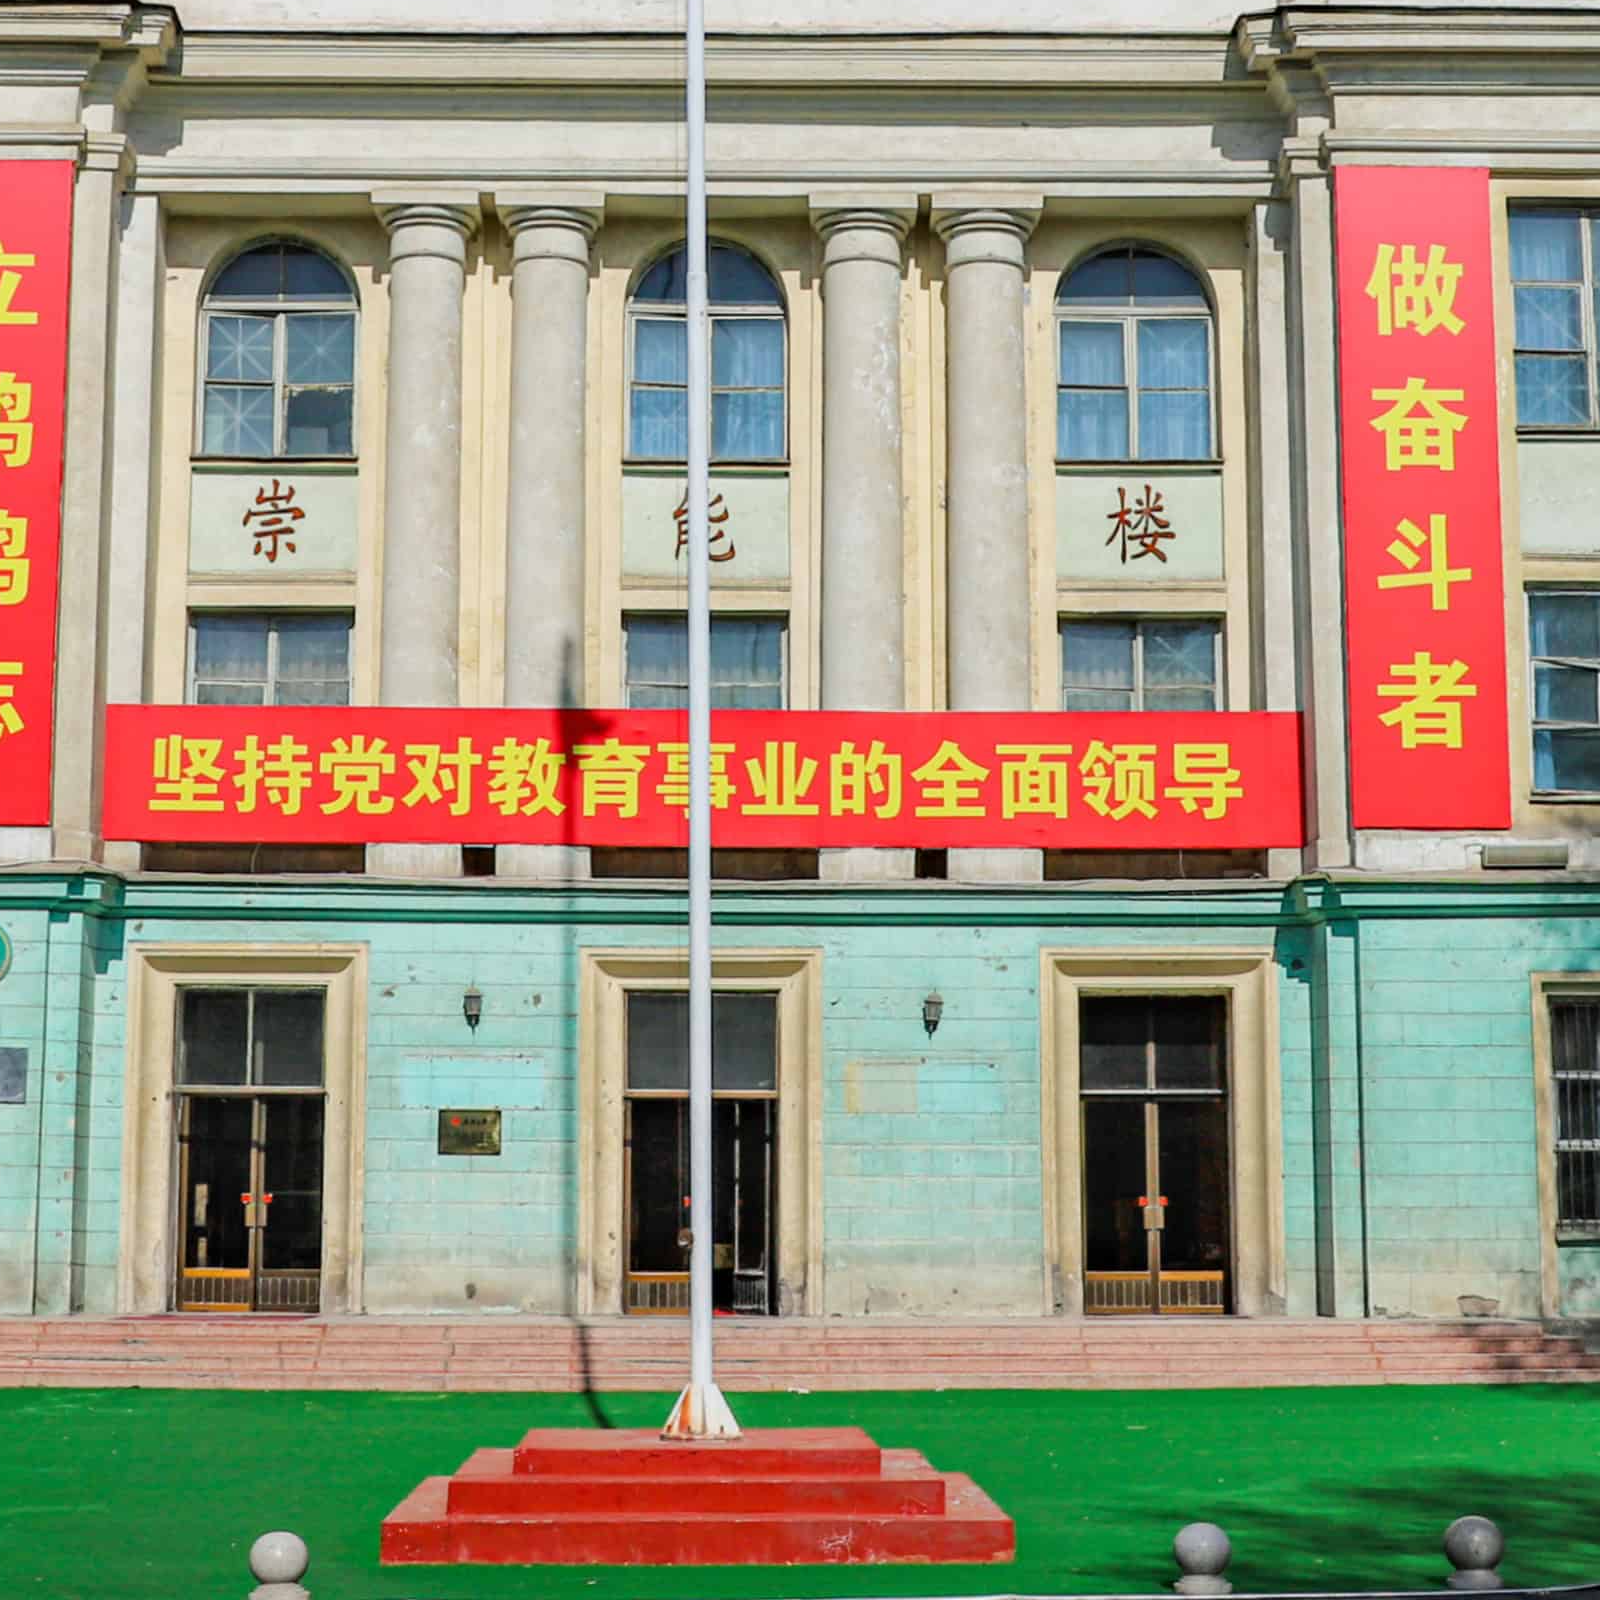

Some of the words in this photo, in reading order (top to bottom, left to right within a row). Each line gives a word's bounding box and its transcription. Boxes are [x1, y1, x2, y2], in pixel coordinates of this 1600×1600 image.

[1365, 243, 1478, 750] 做奋斗者
[148, 733, 1244, 821] 坚持党对教育事业的全面领导
